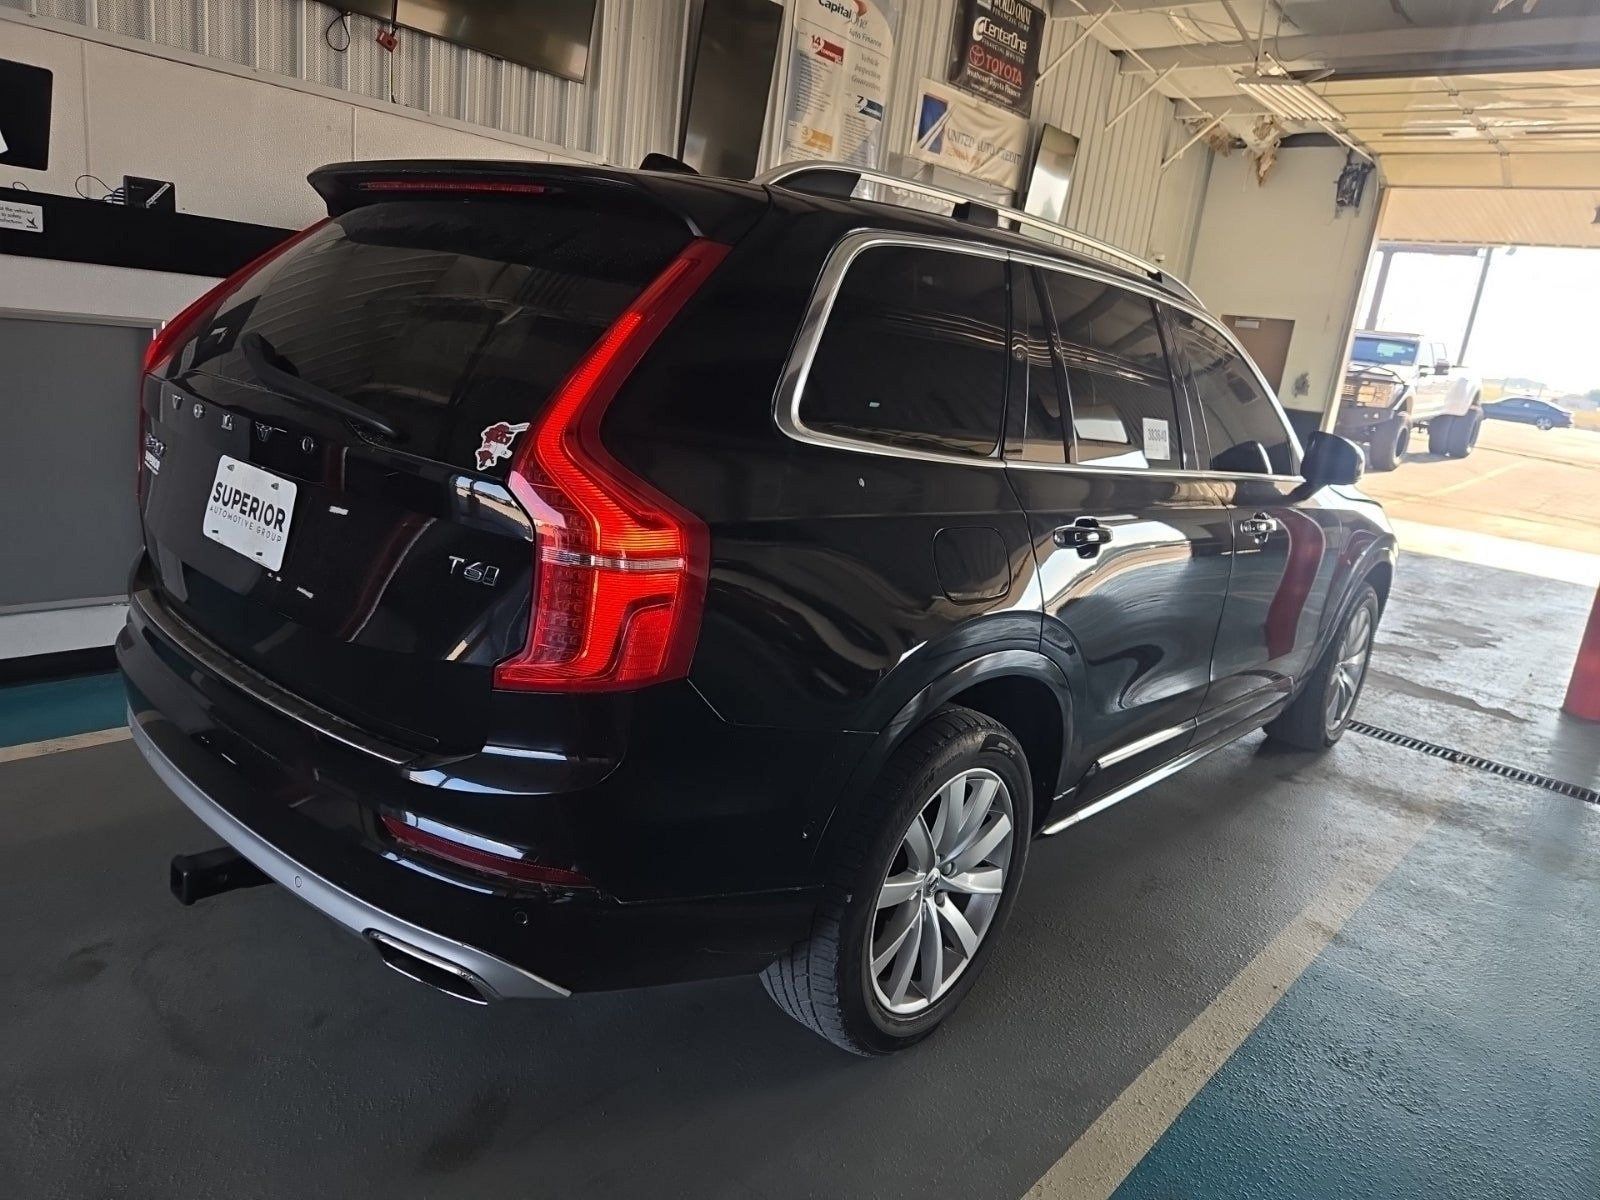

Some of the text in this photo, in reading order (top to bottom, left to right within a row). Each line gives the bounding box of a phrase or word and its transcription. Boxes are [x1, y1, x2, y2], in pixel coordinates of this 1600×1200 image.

[986, 54, 1022, 86] TOYOTA
[209, 504, 283, 543] AUTOMOTIVE GROUP
[212, 481, 287, 533] SUPERIOR
